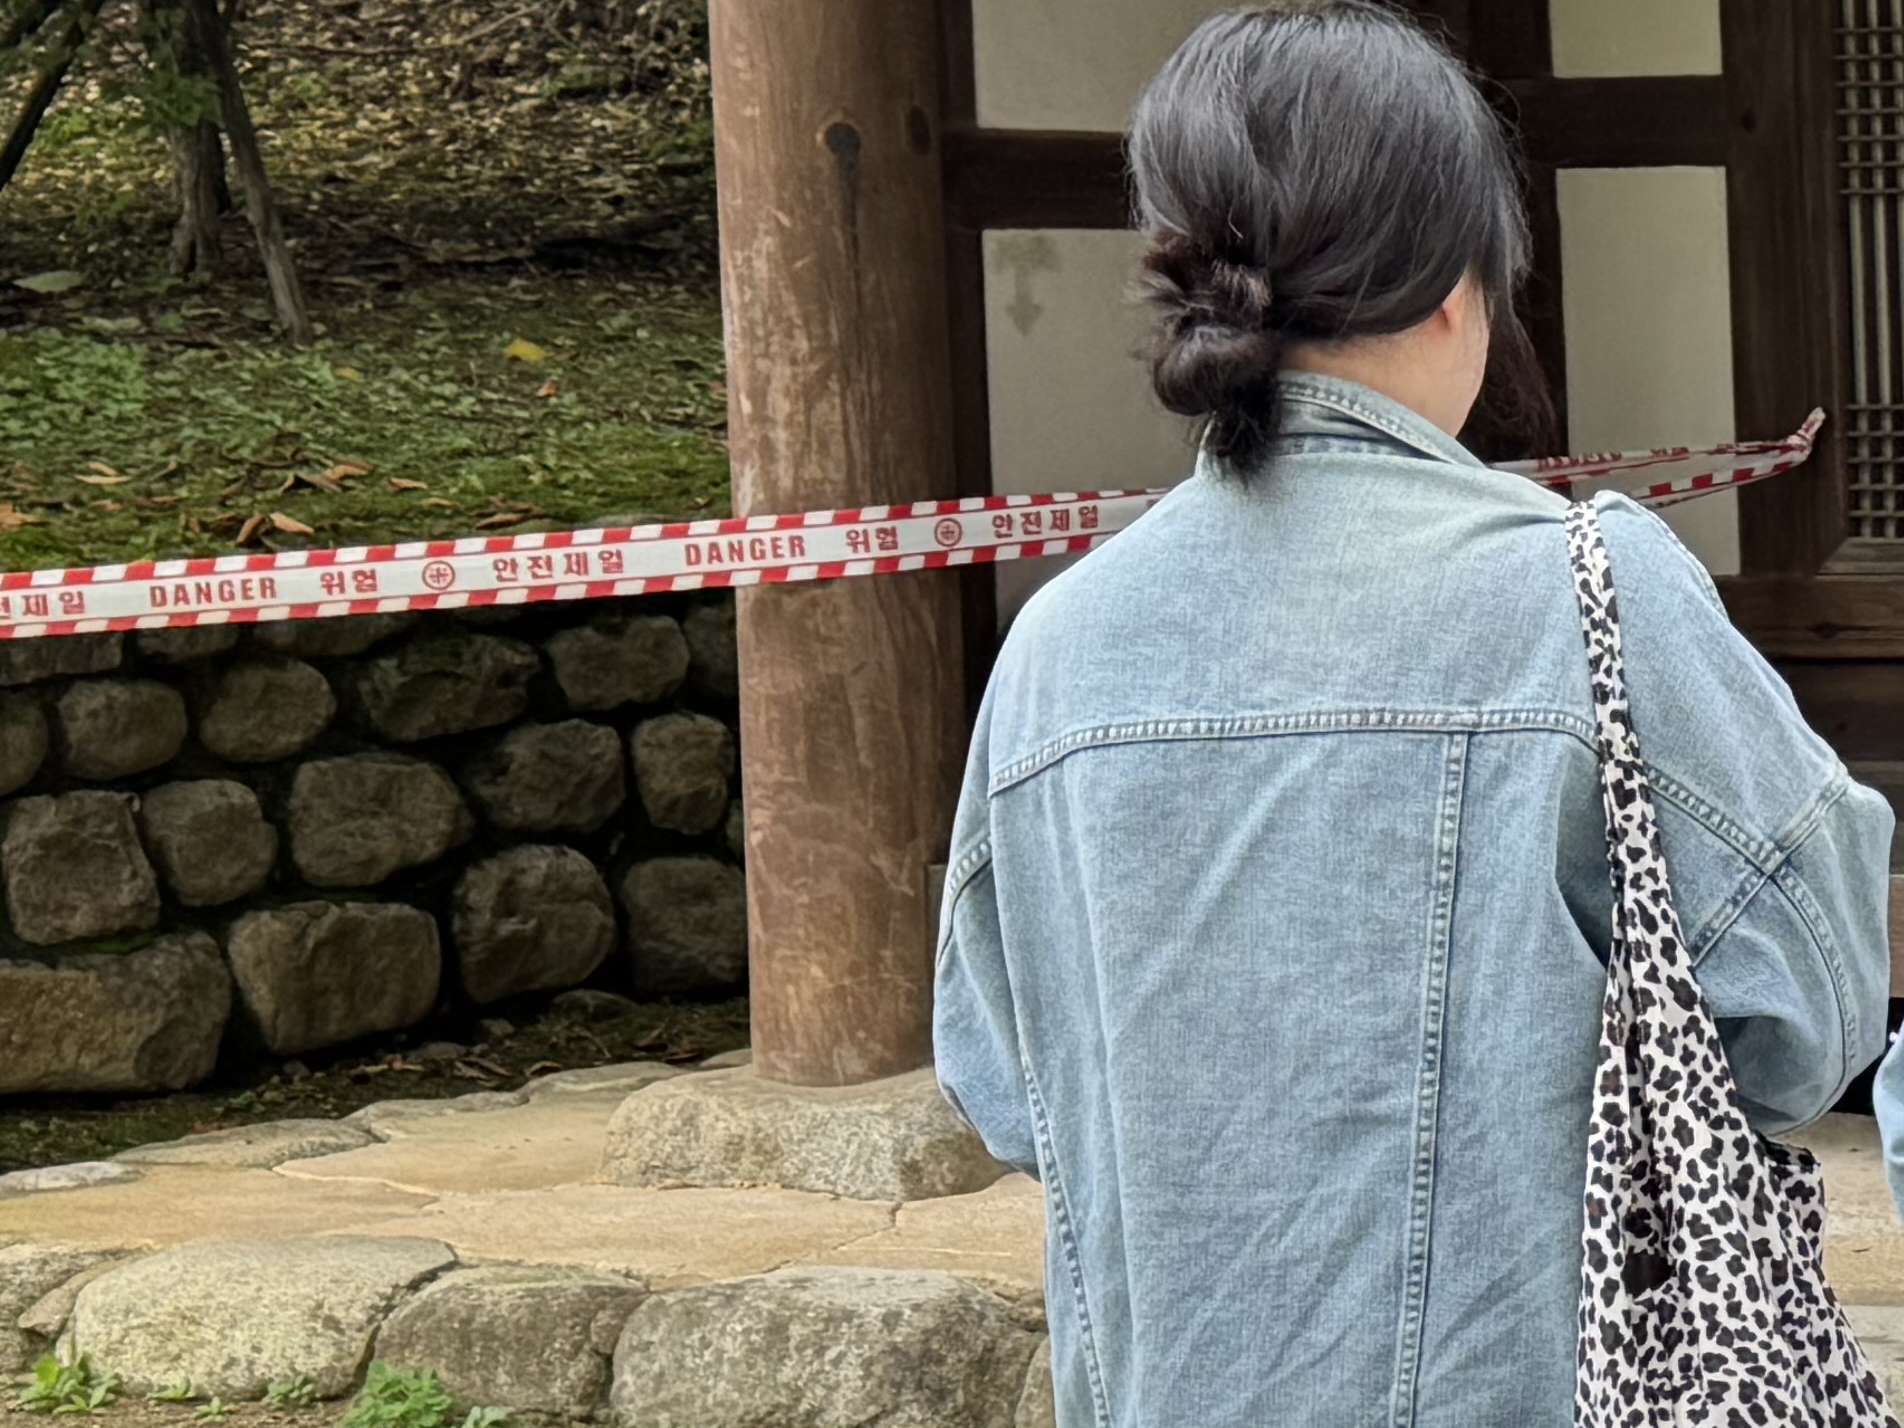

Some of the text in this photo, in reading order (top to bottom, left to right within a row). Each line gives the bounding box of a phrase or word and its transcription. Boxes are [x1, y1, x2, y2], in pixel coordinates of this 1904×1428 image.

[150, 576, 277, 609] DANGER
[320, 568, 378, 596] 위험
[492, 549, 624, 582] 안전제일
[684, 534, 806, 566] DANGER
[846, 526, 899, 554] 위험
[992, 505, 1098, 539] 안전제일
